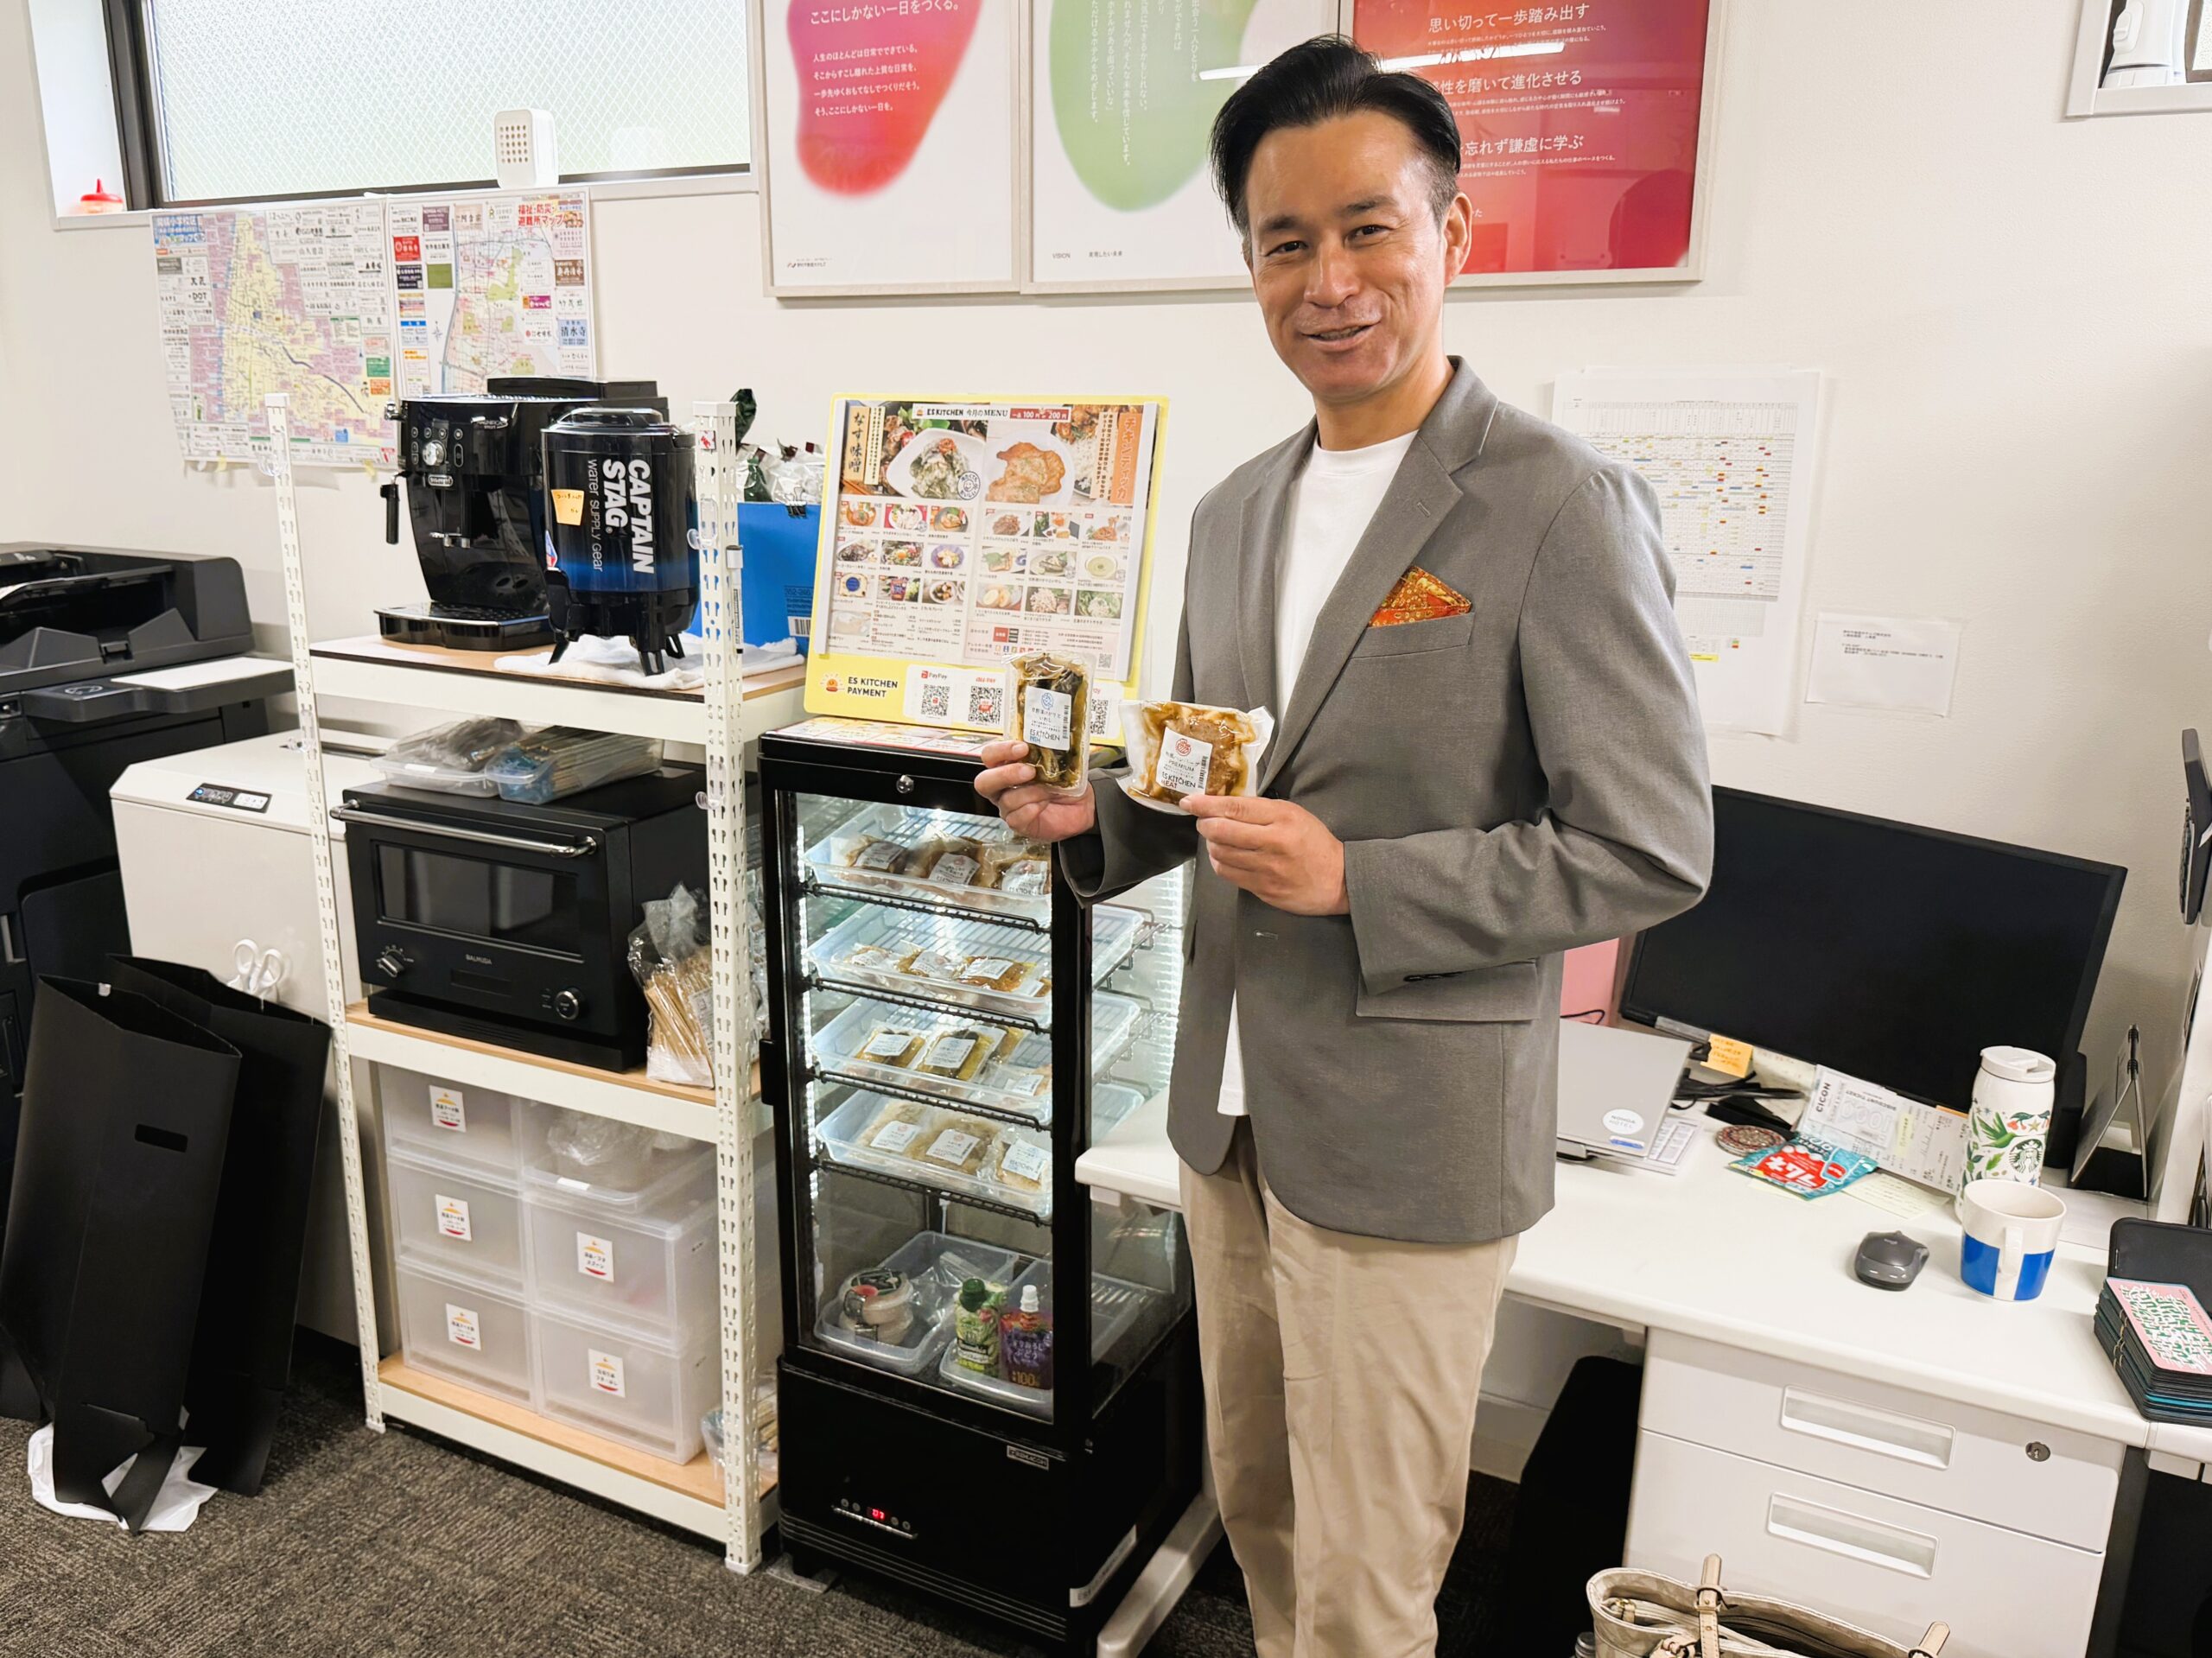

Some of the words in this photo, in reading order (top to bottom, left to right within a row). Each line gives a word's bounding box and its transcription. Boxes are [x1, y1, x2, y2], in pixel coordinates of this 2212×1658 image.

[1428, 3, 1590, 34] 思い切って一歩踏み出す
[1460, 135, 1585, 156] 忘れず謙虚に学ぶ
[561, 326, 586, 337] 清水寺
[849, 412, 865, 473] なす味噌
[603, 459, 629, 528] STAG
[628, 459, 655, 574] CAPTAIN
[848, 677, 858, 685] ES
[861, 677, 899, 689] KITCHEN
[847, 687, 887, 698] PAYMENT
[1036, 730, 1060, 741] KITCHEN
[1168, 759, 1194, 772] PREMIUM
[1168, 774, 1196, 788] KITCHEN
[466, 953, 493, 965] BALMUDA
[1815, 1083, 1831, 1113] CICON
[1765, 1155, 1818, 1188] ラムネ
